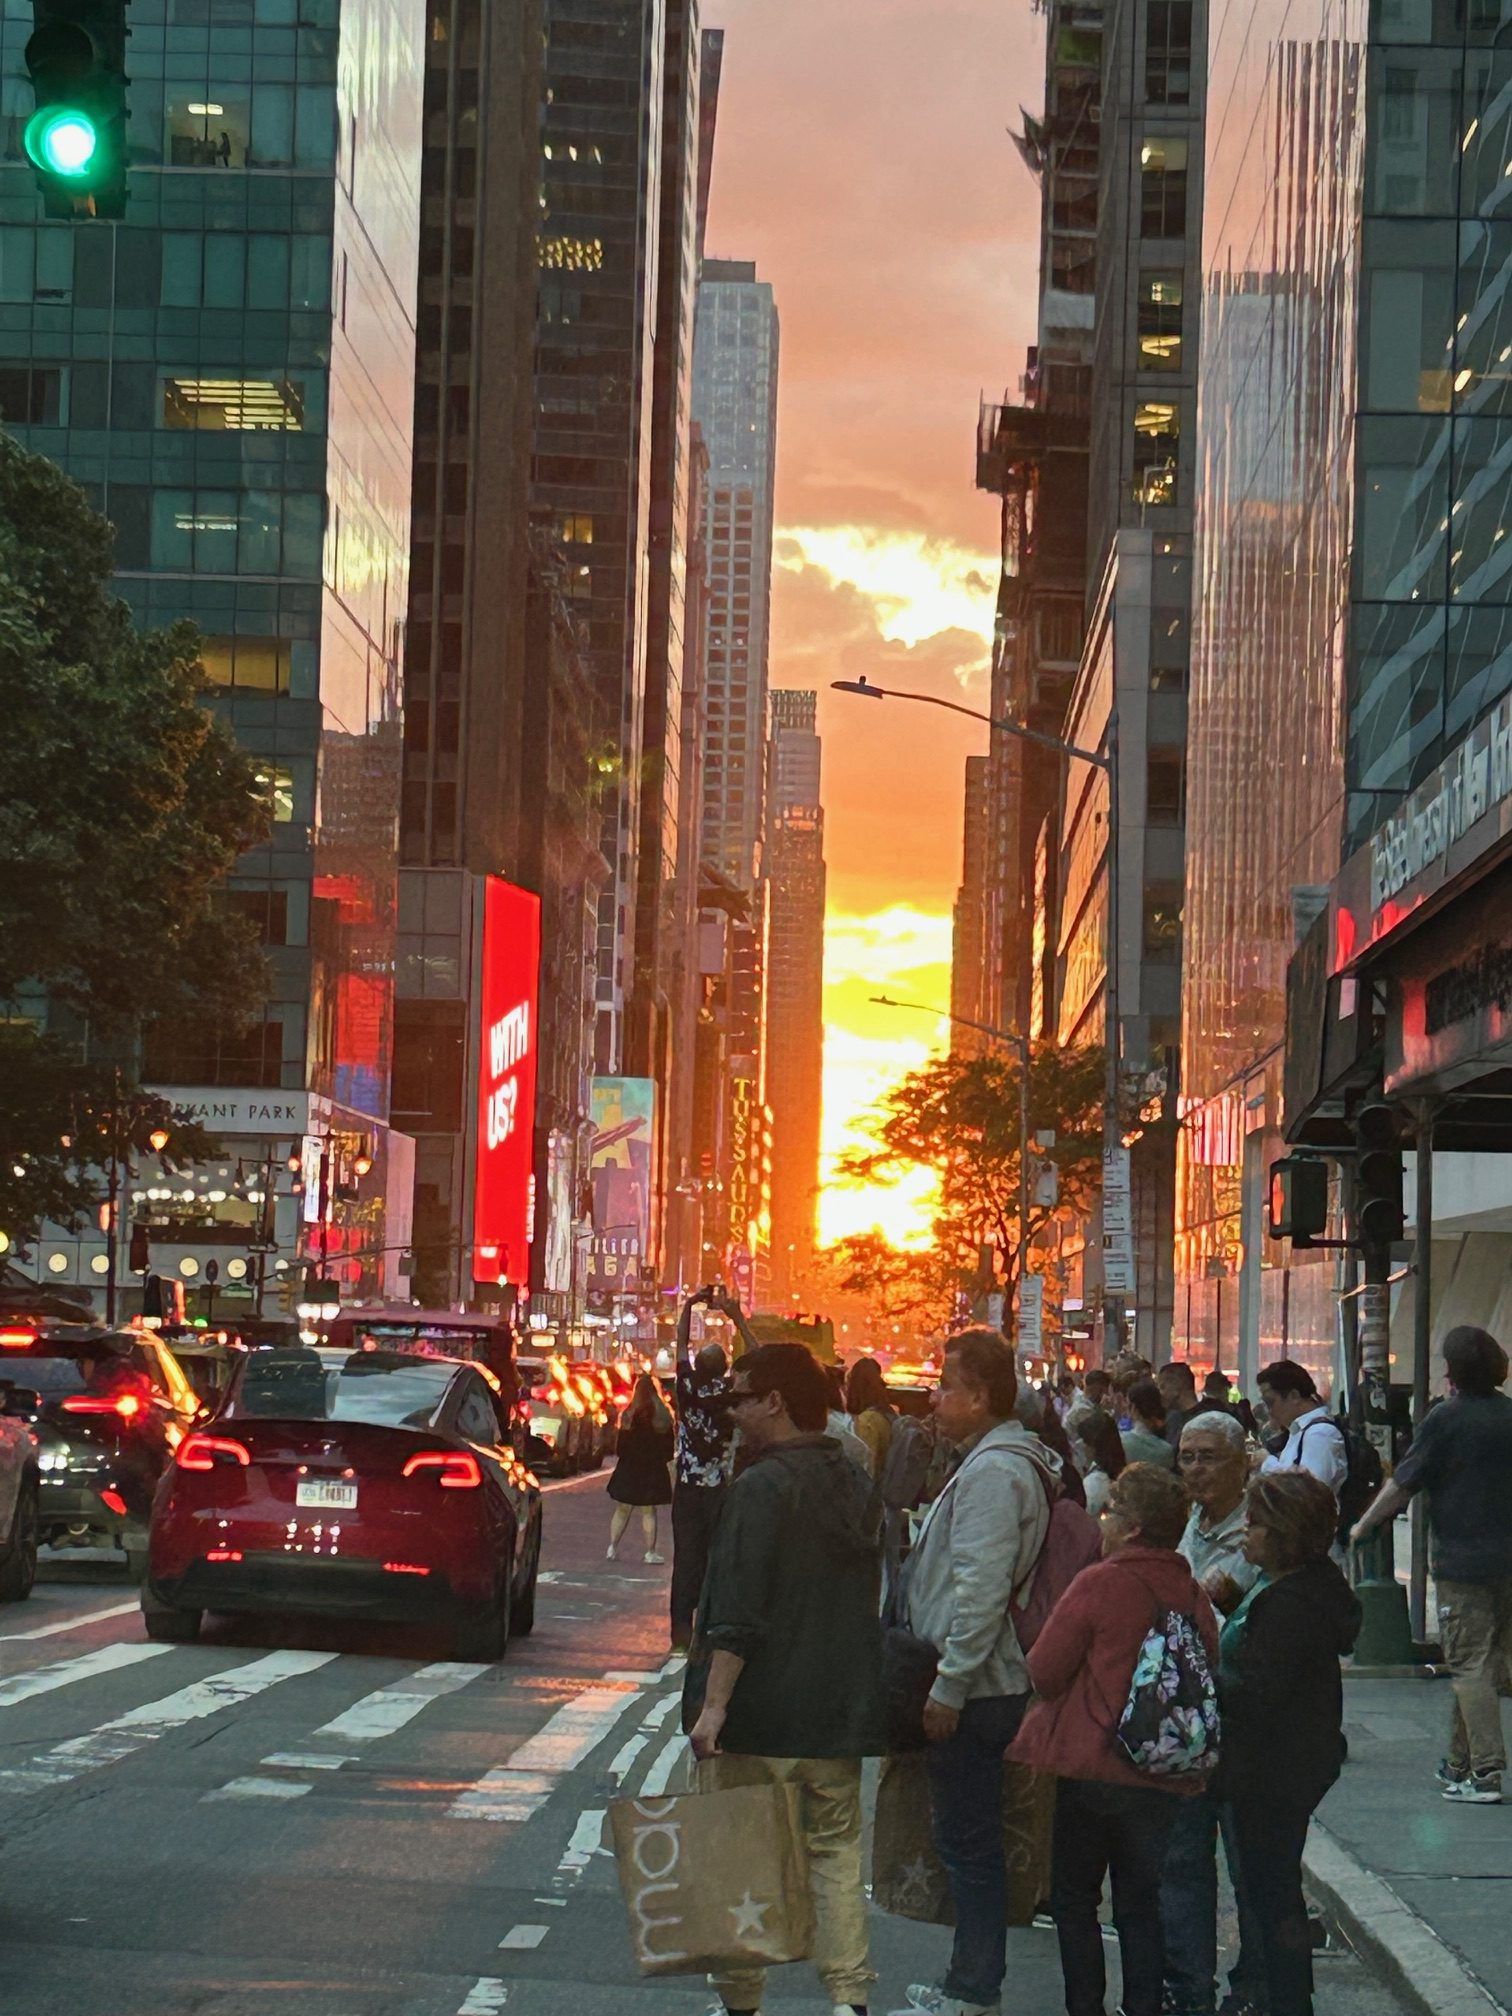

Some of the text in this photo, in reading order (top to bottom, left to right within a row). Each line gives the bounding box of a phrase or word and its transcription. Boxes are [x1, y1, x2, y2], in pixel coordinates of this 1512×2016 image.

[490, 1000, 529, 1080] WITH
[249, 1105, 296, 1119] PARK
[487, 1075, 518, 1150] US?
[731, 1078, 750, 1245] TUSSAUDS
